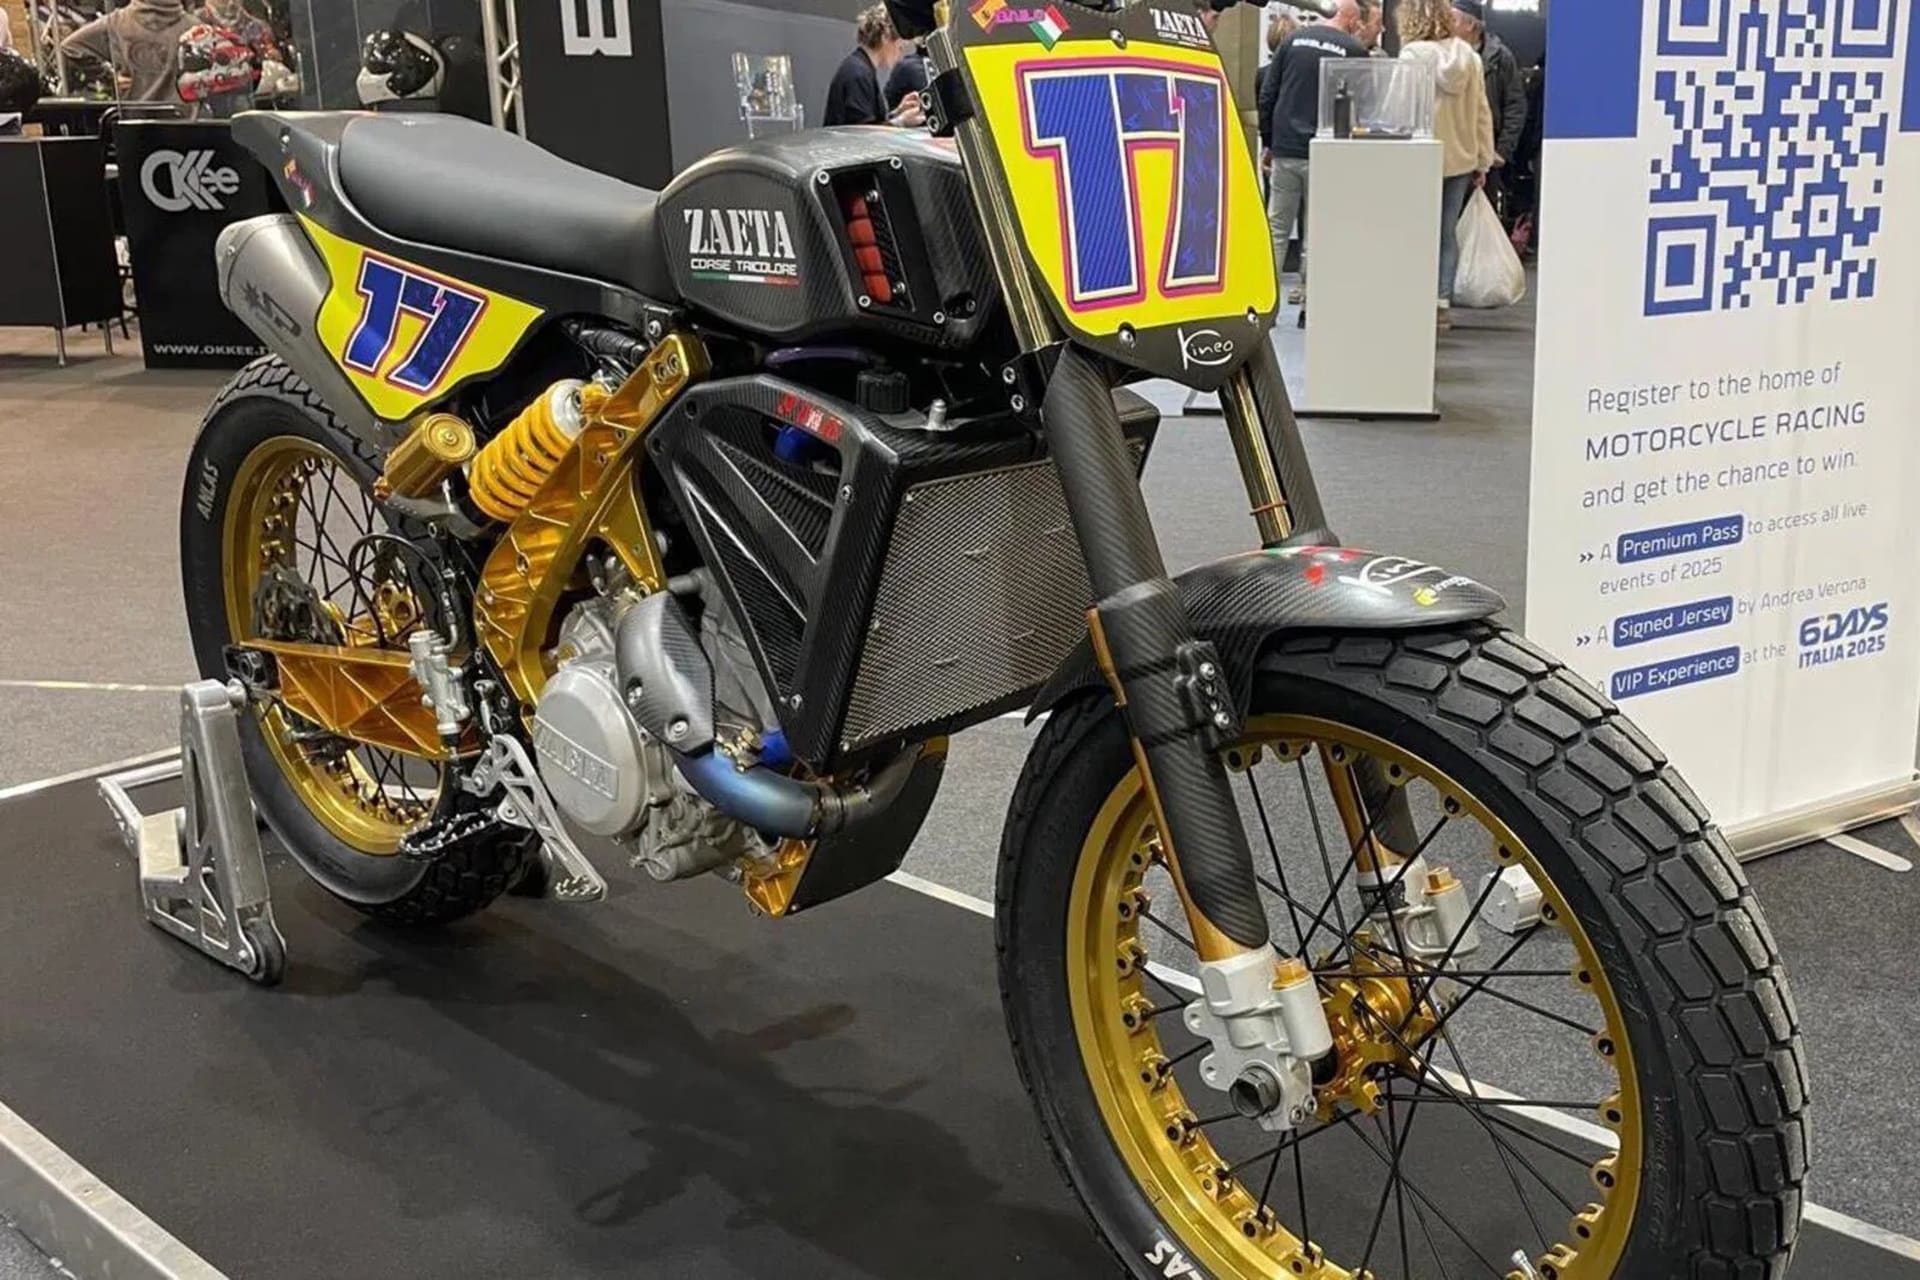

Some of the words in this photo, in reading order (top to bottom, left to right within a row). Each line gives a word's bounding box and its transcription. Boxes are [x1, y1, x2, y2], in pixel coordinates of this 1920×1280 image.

[1149, 8, 1209, 39] ZAETA
[1019, 60, 1226, 306] 17
[683, 209, 796, 259] ZAETA
[690, 258, 731, 271] CORSE
[736, 260, 797, 276] TRICOLORE
[341, 252, 489, 395] 17
[1177, 327, 1234, 370] Kineo
[1588, 384, 1682, 414] Register
[1689, 379, 1710, 399] to
[1718, 373, 1750, 396] the
[1759, 370, 1814, 391] home
[1821, 361, 1841, 385] of
[1586, 416, 1767, 461] MOTORCYCLE
[1776, 402, 1865, 435] RACING
[1582, 480, 1624, 508] and
[1634, 476, 1667, 504] get
[1676, 471, 1710, 493] the
[1717, 464, 1789, 487] chance
[1797, 456, 1815, 475] to
[1600, 543, 1612, 560] A
[1623, 532, 1697, 557] Premium
[1702, 524, 1739, 543] Pass
[1748, 520, 1763, 534] to
[1767, 511, 1817, 532] access
[1821, 505, 1839, 522] all
[1842, 502, 1868, 519] live
[1600, 572, 1655, 595] events
[1660, 564, 1676, 583] of
[1680, 556, 1723, 579] 2025
[1597, 626, 1608, 644] A
[1619, 613, 1674, 639] Signed
[1678, 604, 1730, 627] Jersey
[1738, 598, 1755, 615] by
[1760, 589, 1814, 610] Andrea
[1818, 577, 1867, 598] Verona
[1799, 602, 1889, 646] 6DAYS
[1615, 672, 1643, 693] VIP
[1648, 653, 1736, 686] Experience
[1743, 649, 1758, 664] at
[1763, 643, 1787, 660] the
[1799, 644, 1845, 669] ITALIA
[1847, 635, 1886, 658] 2025
